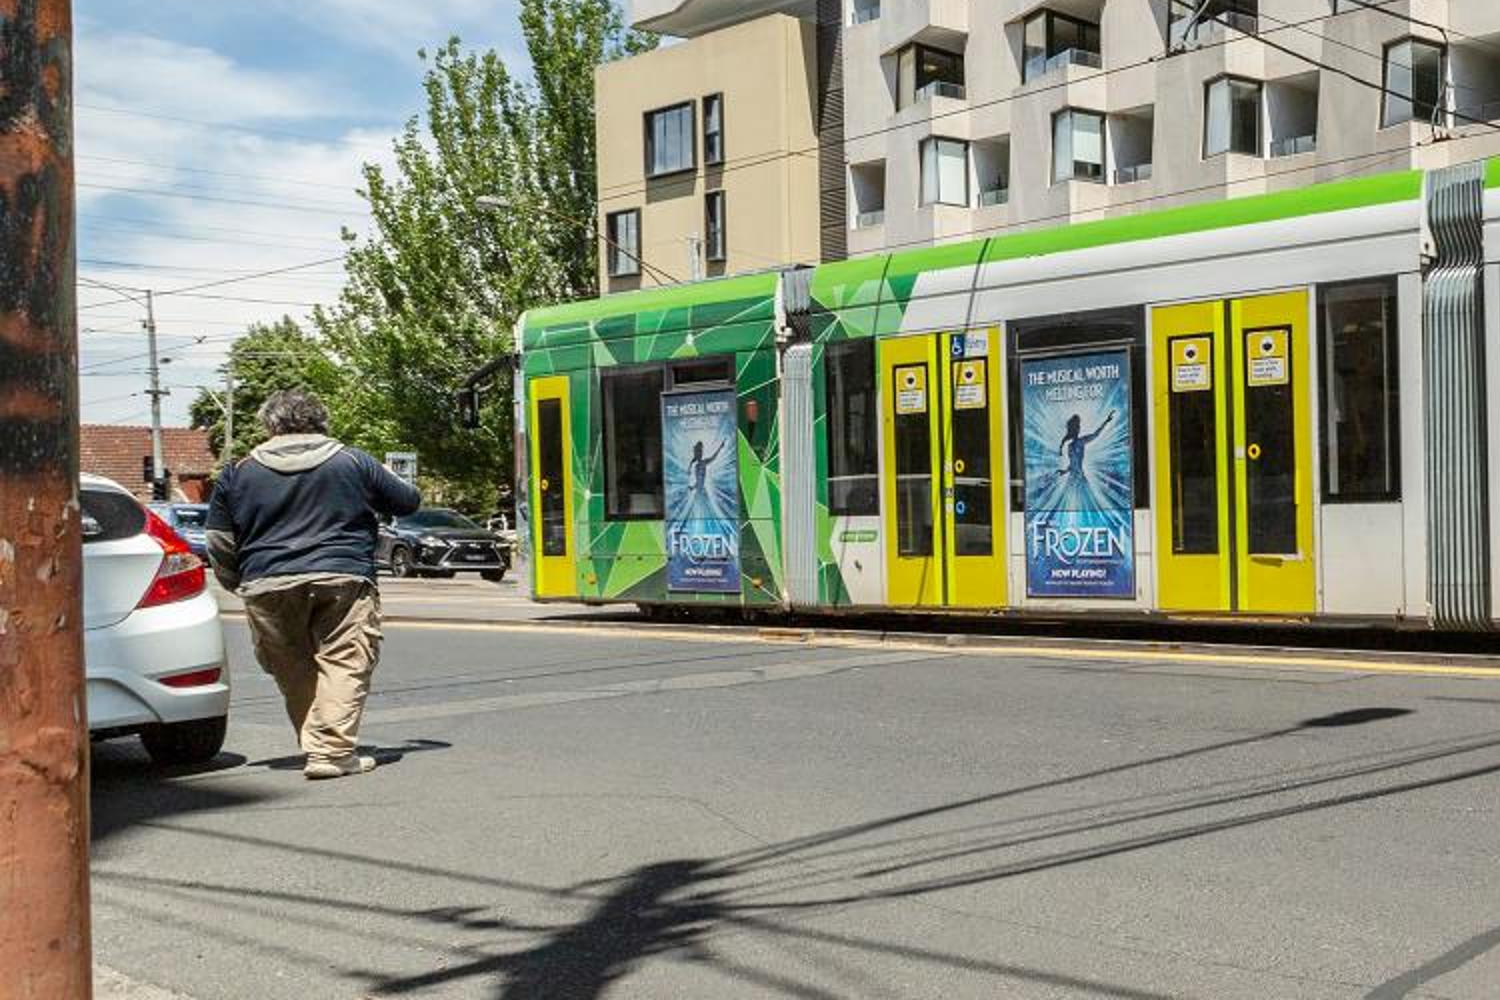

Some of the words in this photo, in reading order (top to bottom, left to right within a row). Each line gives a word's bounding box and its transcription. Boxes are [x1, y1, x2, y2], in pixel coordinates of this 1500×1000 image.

[1027, 371, 1046, 385] THE
[671, 525, 738, 565] FROZEN
[1032, 521, 1125, 565] FROZEN
